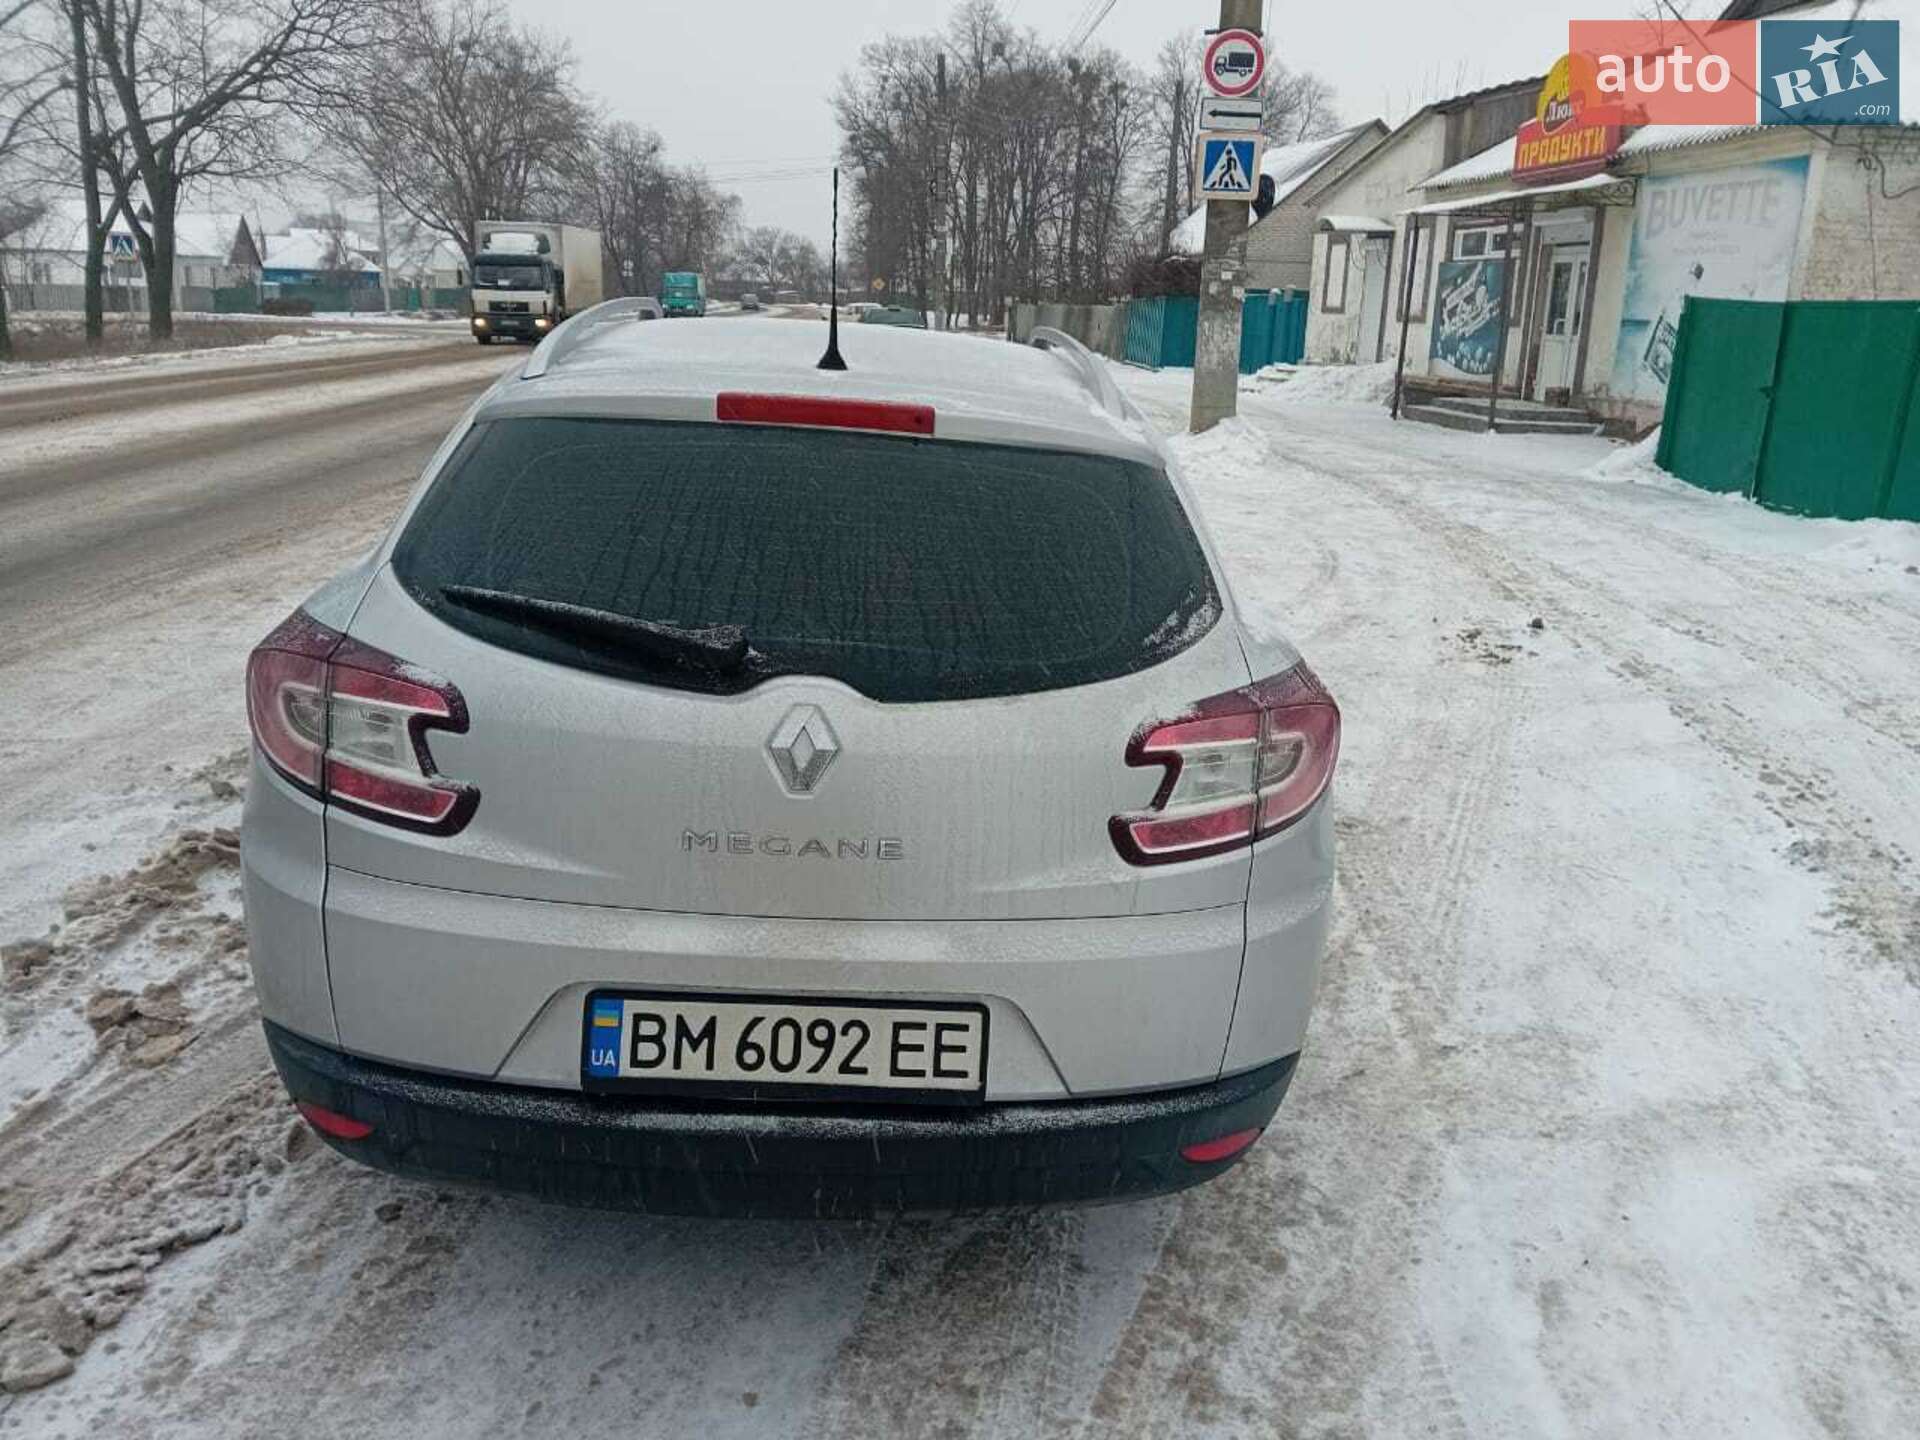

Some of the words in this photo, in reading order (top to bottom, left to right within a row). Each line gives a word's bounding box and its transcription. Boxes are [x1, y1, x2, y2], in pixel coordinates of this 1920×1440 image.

[1518, 125, 1606, 170] ПРОДУКТИ
[1645, 179, 1780, 239] BUVETTE
[681, 829, 905, 861] MEGANE
[591, 1049, 617, 1068] UA
[629, 1012, 717, 1071] BM
[735, 1016, 871, 1076] 6092
[889, 1022, 970, 1079] EE
